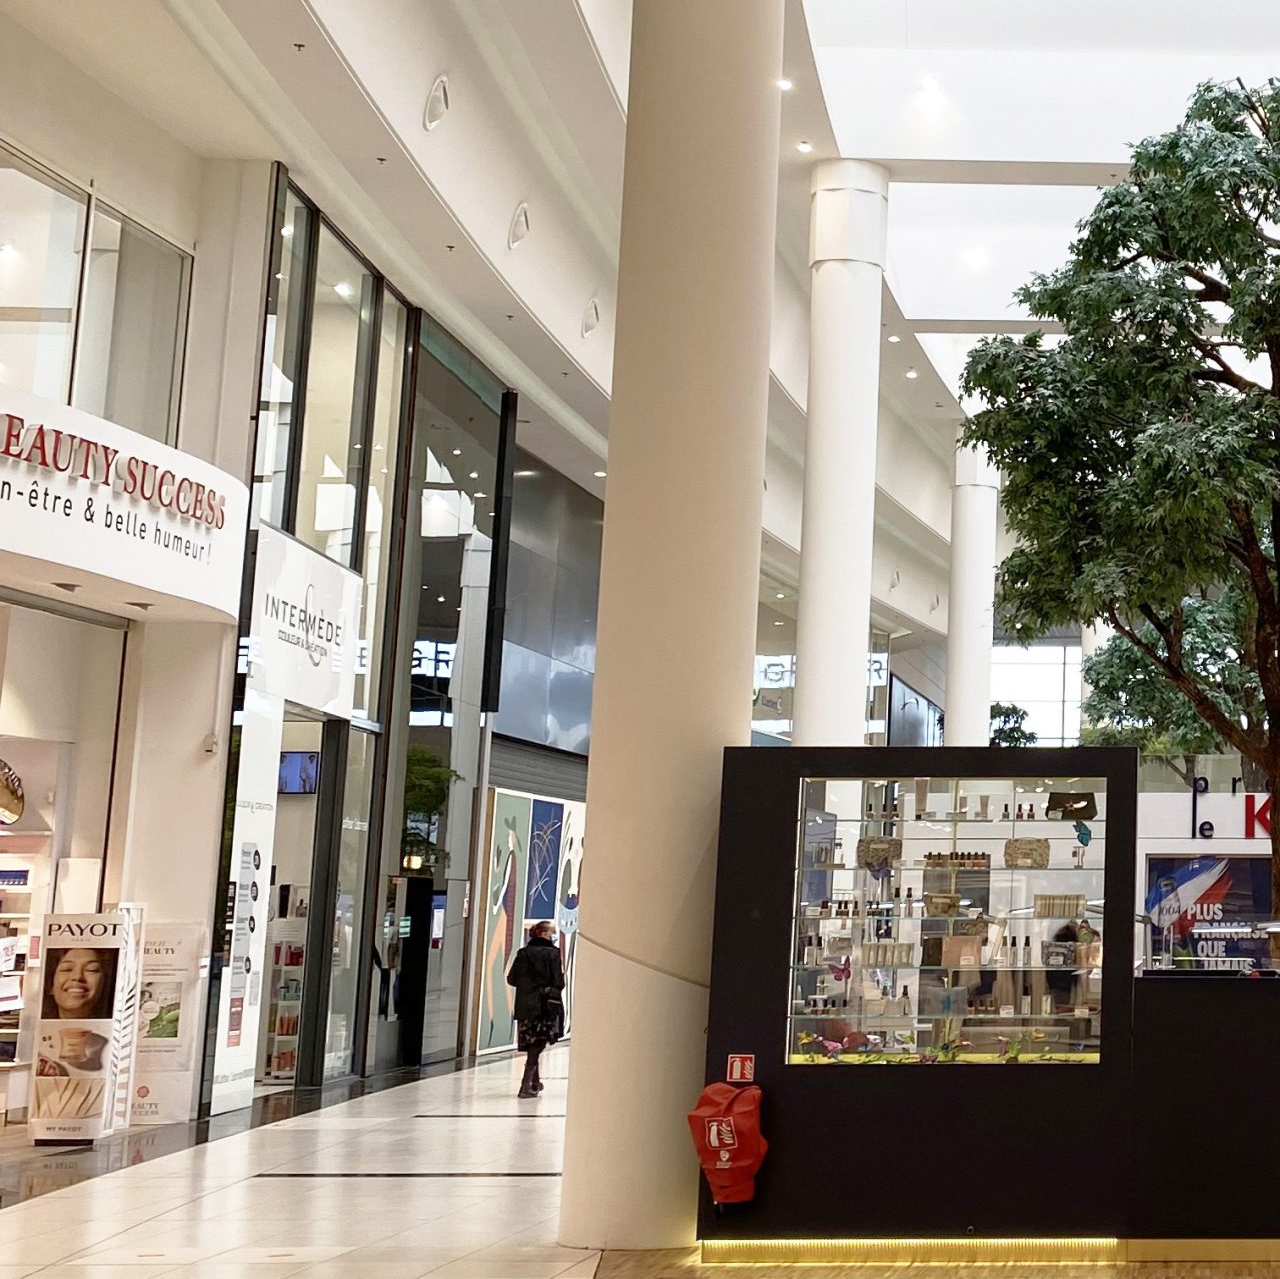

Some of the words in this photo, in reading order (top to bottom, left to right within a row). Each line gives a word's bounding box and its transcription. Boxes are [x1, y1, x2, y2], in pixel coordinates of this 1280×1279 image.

[123, 456, 226, 530] SUCCESS
[84, 497, 95, 524] &
[104, 503, 147, 540] belle
[1187, 903, 1224, 921] PLUS
[47, 923, 124, 937] PAYOT
